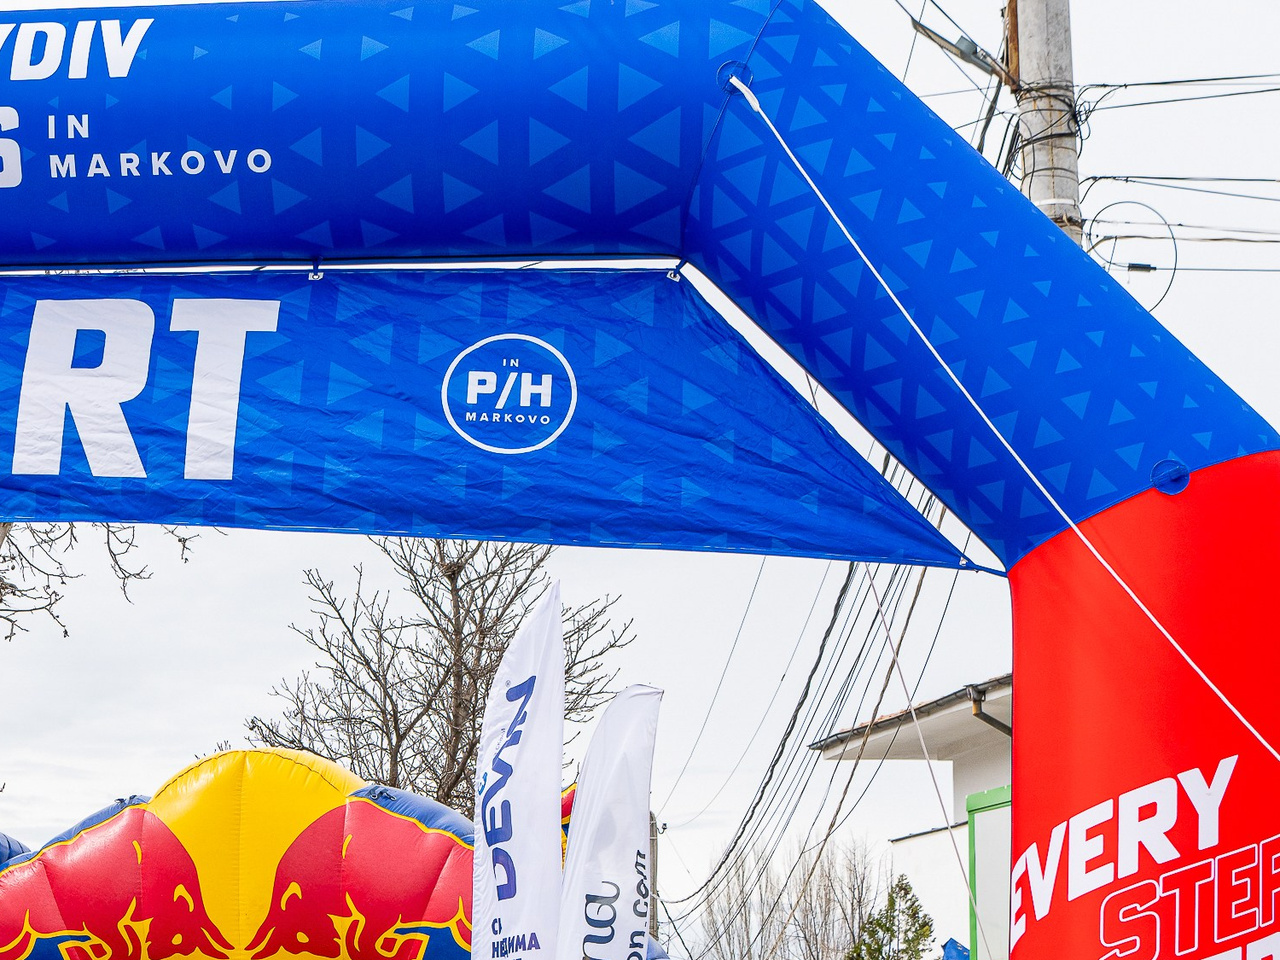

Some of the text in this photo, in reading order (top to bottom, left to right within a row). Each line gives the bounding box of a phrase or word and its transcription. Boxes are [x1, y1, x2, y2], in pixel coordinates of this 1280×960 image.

[47, 114, 90, 139] IN
[49, 148, 274, 179] MARKOVO
[502, 358, 519, 367] IN
[466, 371, 553, 410] P/H
[465, 412, 551, 425] MARKOVO
[1009, 754, 1239, 954] EVERY
